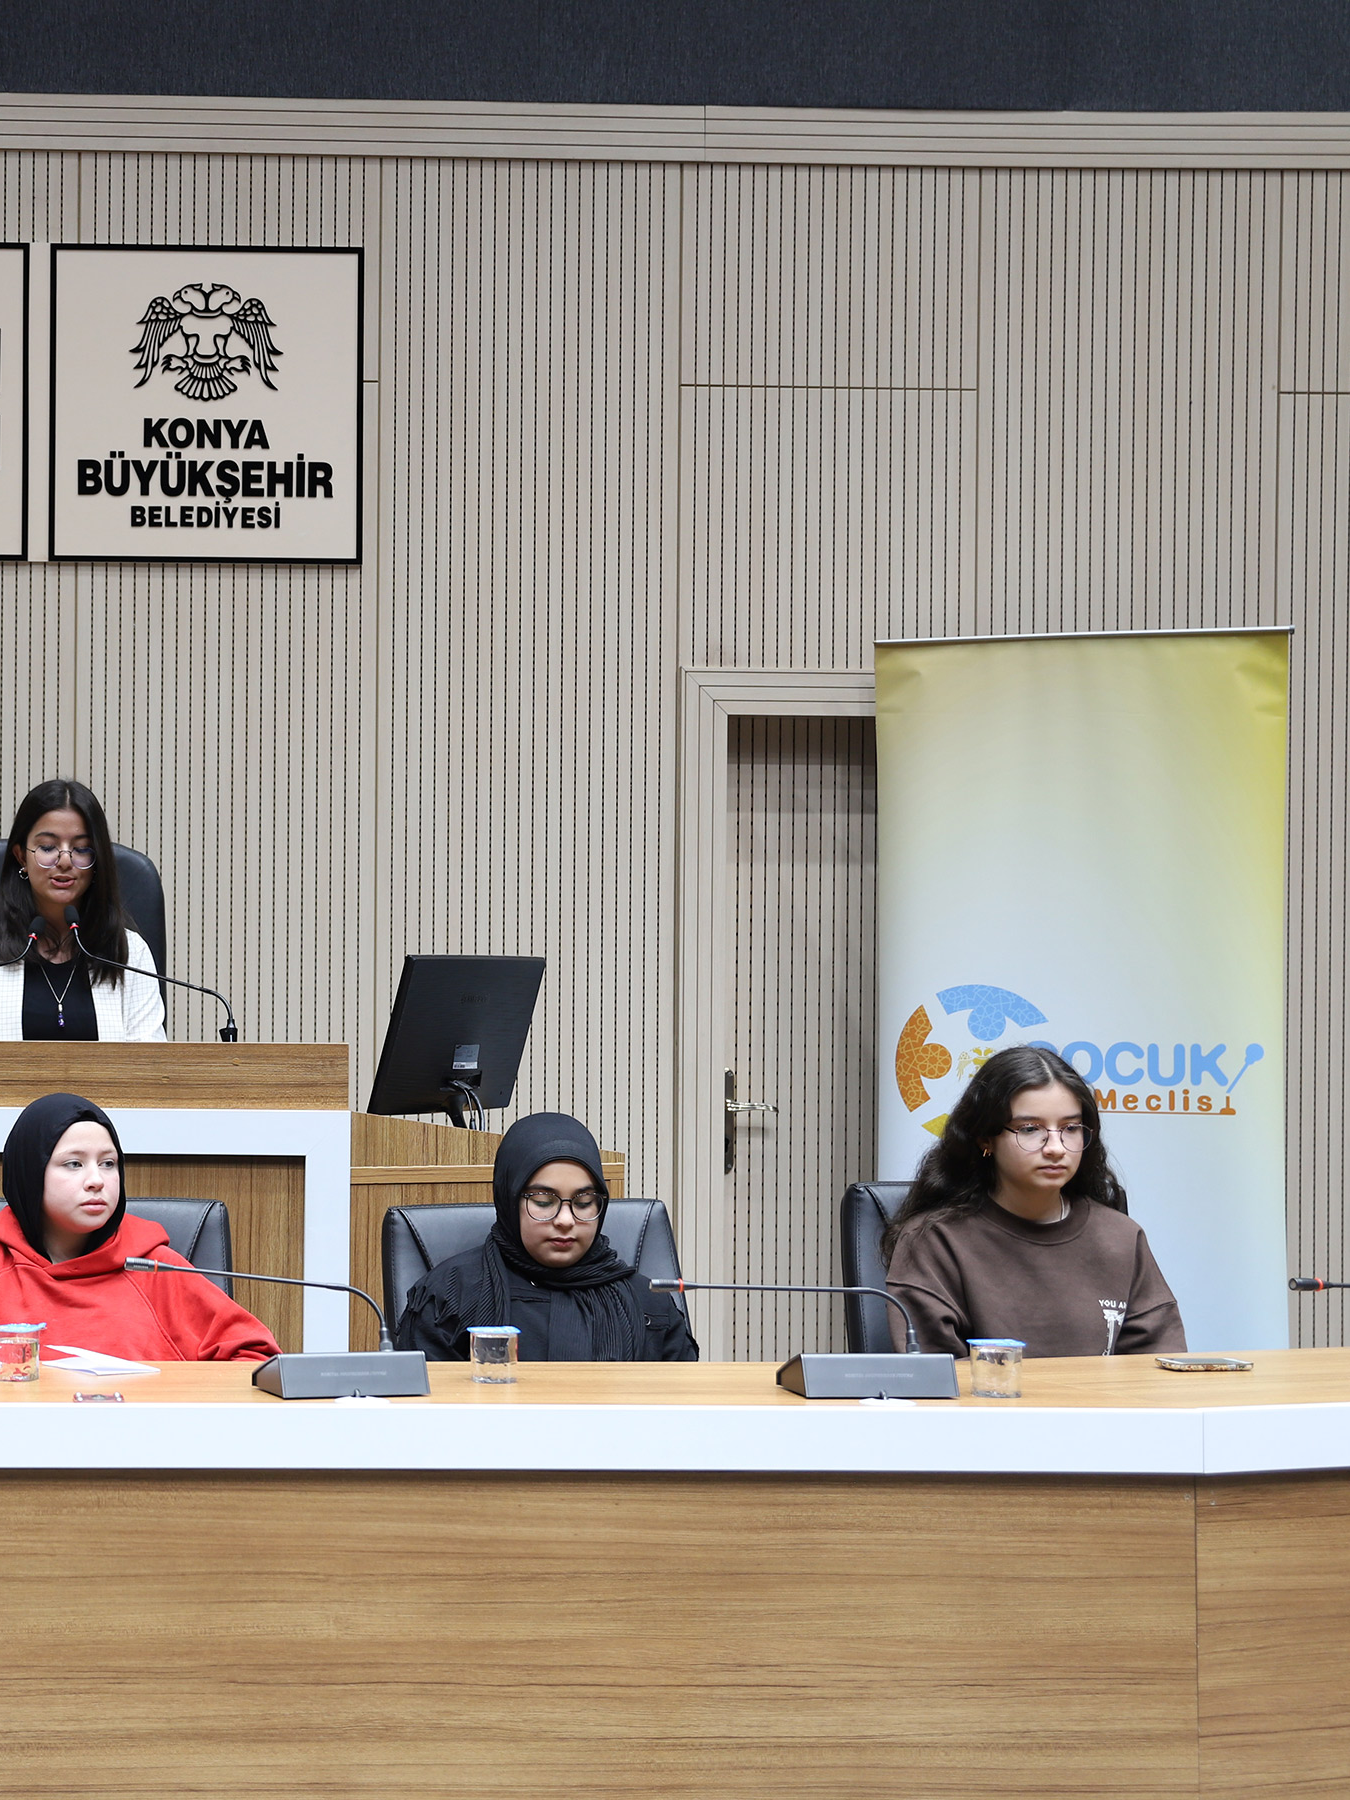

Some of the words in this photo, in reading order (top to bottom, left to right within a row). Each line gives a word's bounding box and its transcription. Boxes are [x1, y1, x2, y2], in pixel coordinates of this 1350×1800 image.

[142, 417, 270, 450] KONYA
[77, 450, 334, 504] BÜYÜKŞEHİR
[130, 500, 282, 529] BELEDİYESİ
[1098, 1299, 1117, 1308] YOU
